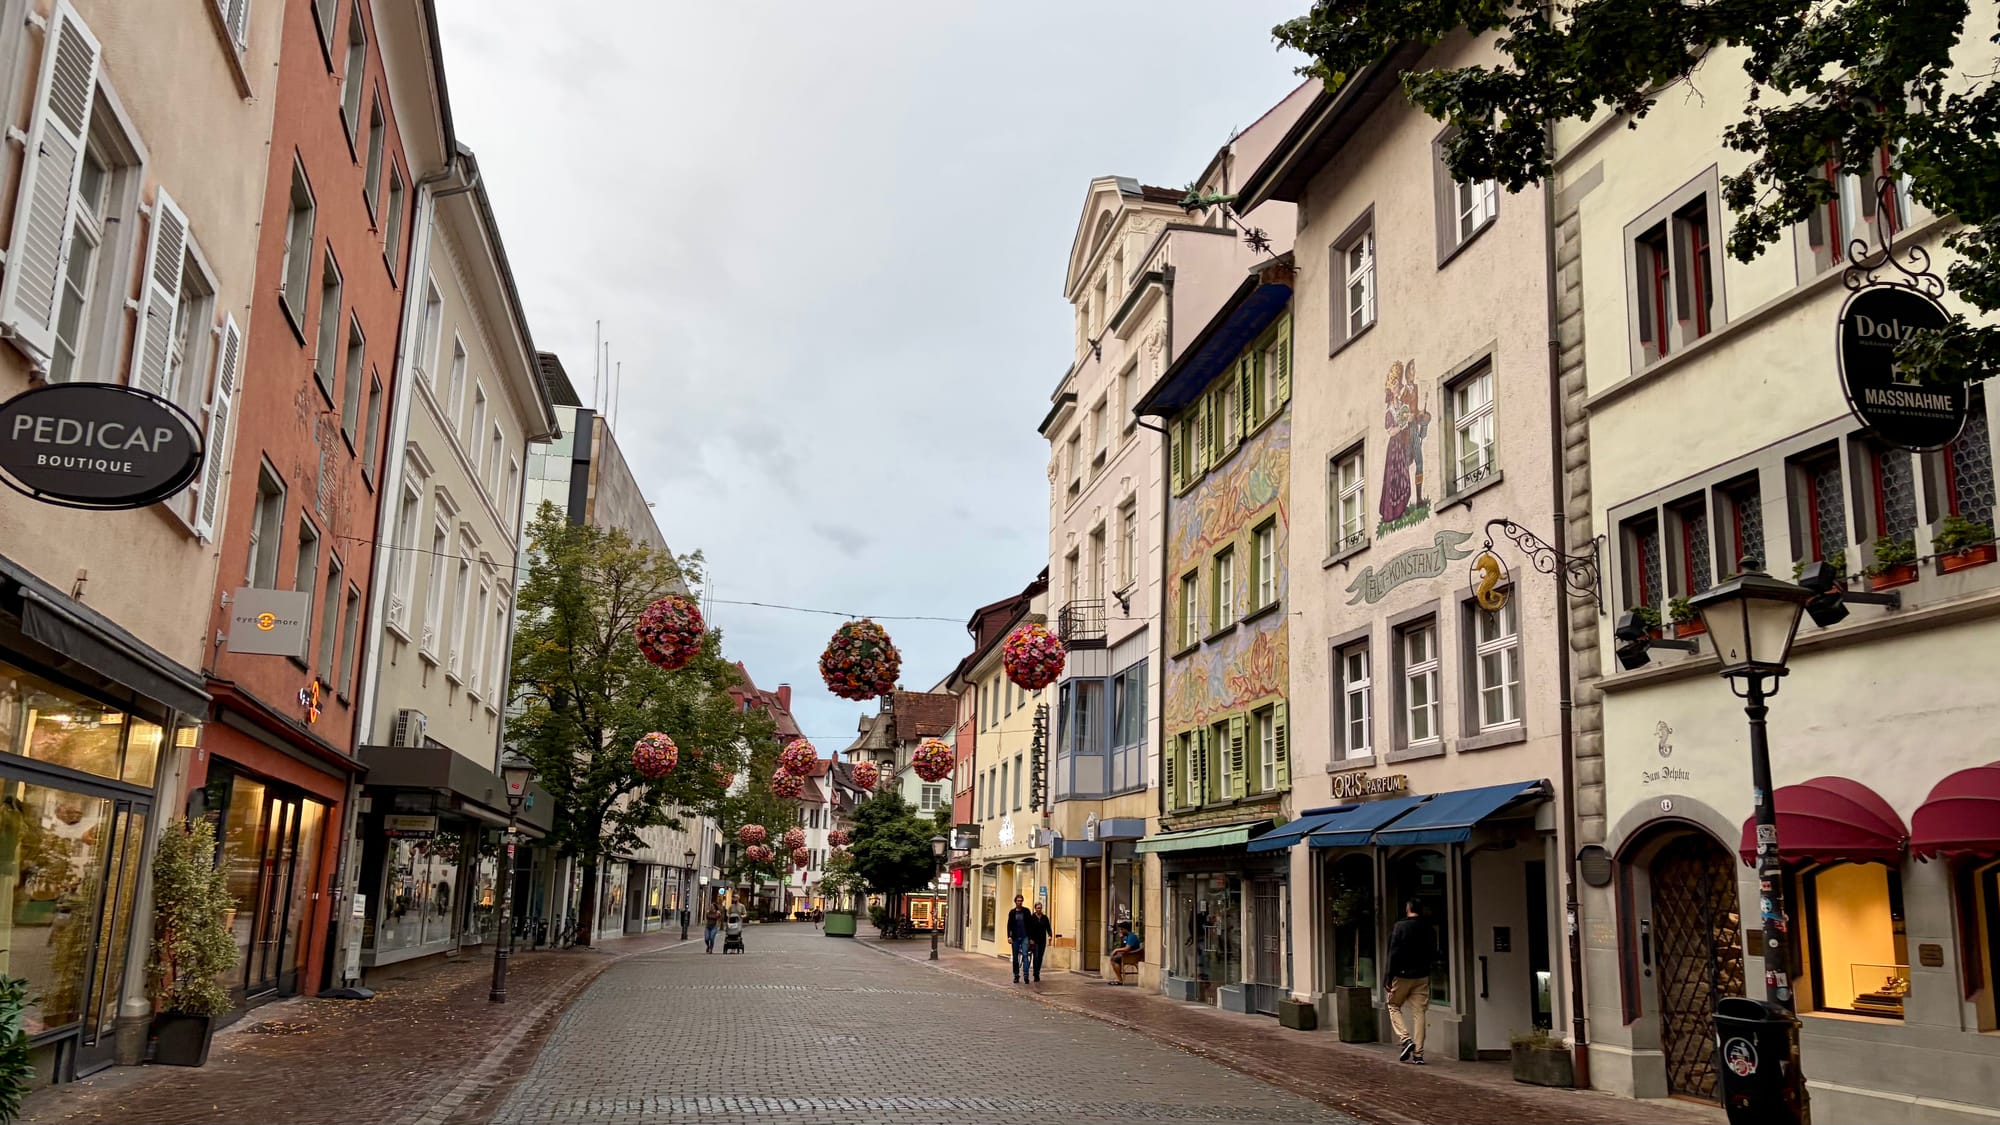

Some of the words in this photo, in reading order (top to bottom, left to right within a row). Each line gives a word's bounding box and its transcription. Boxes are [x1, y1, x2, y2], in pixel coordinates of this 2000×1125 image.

[1864, 388, 1954, 412] MASSNAHME
[11, 414, 173, 453] PEDICAP
[37, 454, 133, 473] BOUTIQUE
[1368, 549, 1442, 600] ALT-KONSTANZ
[236, 616, 258, 624] eyes
[275, 617, 299, 626] more
[1730, 647, 1737, 660] 4
[1661, 766, 1690, 782] Delphin
[1330, 772, 1363, 799] LORIS
[1365, 777, 1402, 796] PARFUM
